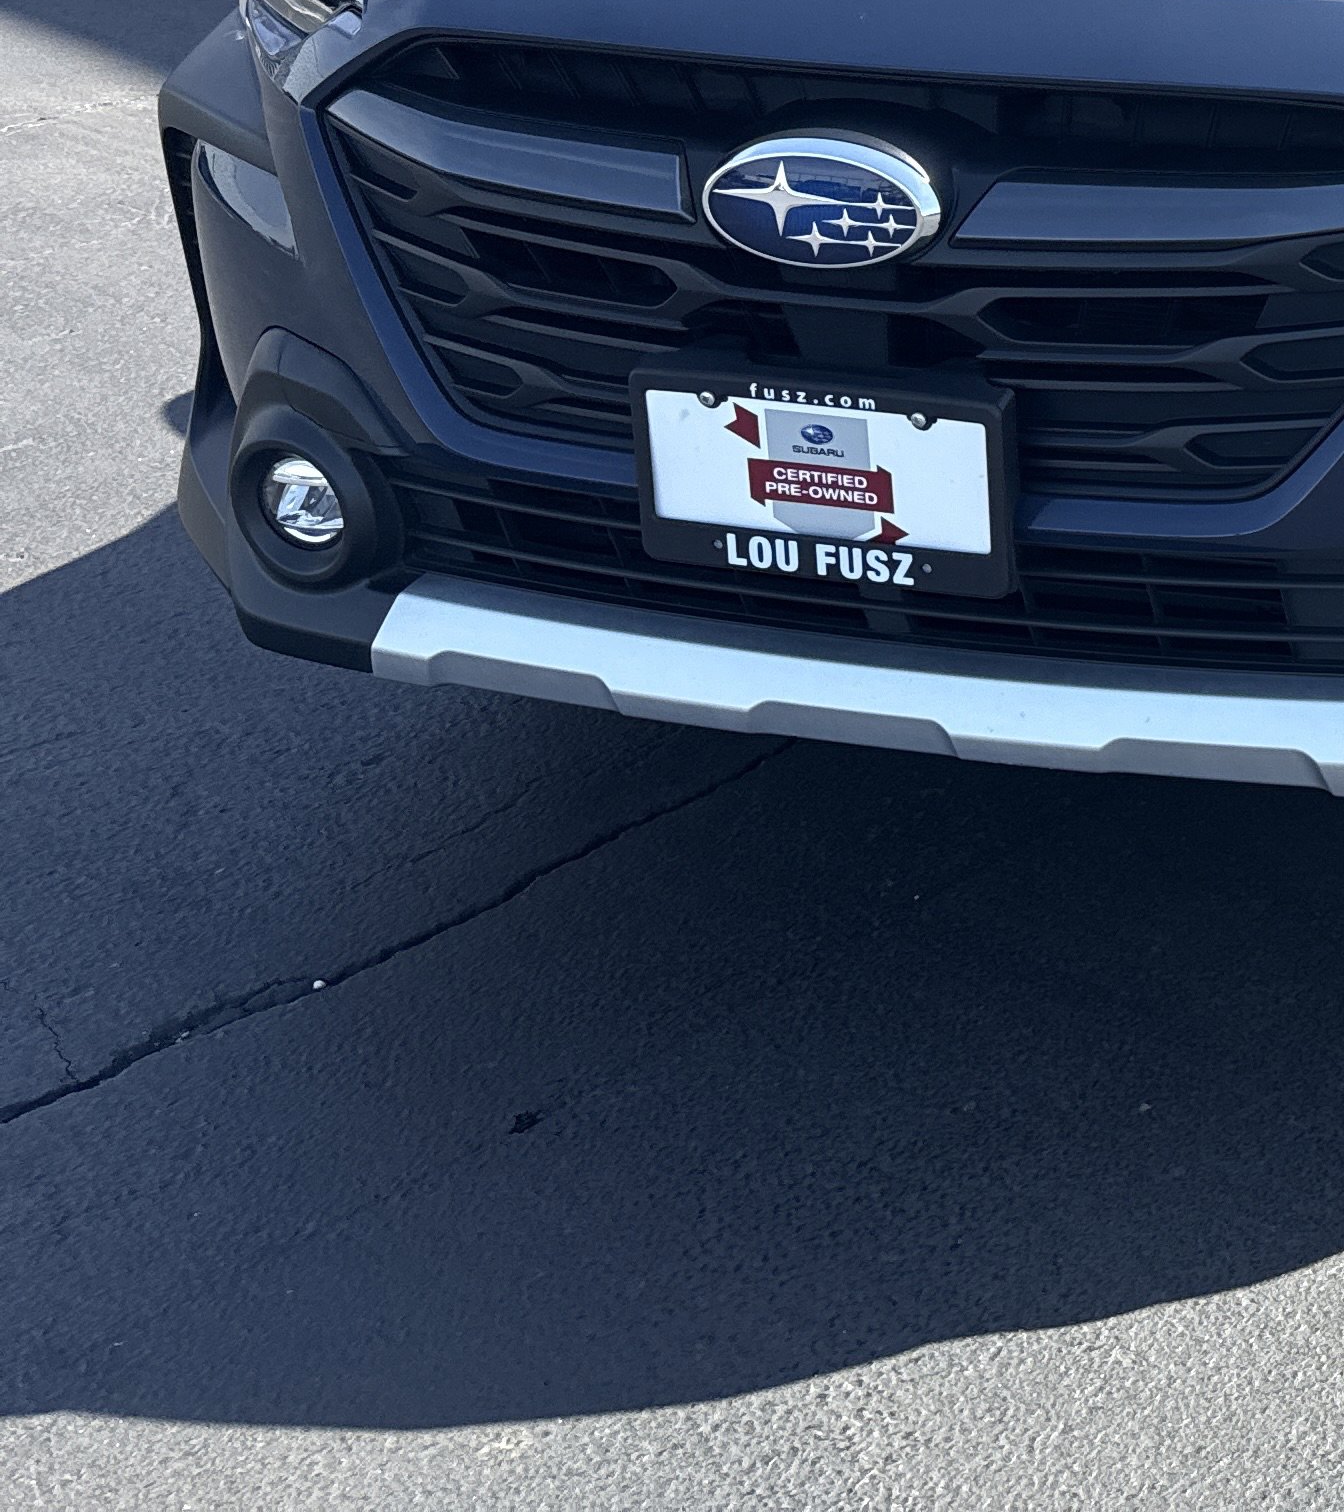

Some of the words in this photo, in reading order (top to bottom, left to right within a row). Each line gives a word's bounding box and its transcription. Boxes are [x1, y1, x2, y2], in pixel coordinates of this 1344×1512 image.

[749, 382, 877, 410] fusz.com
[792, 444, 845, 458] SUBARU
[773, 467, 868, 489] CERTIFIED
[765, 481, 878, 505] PRE-OWNED
[726, 533, 799, 572] LOU
[815, 543, 915, 586] FUSZ
